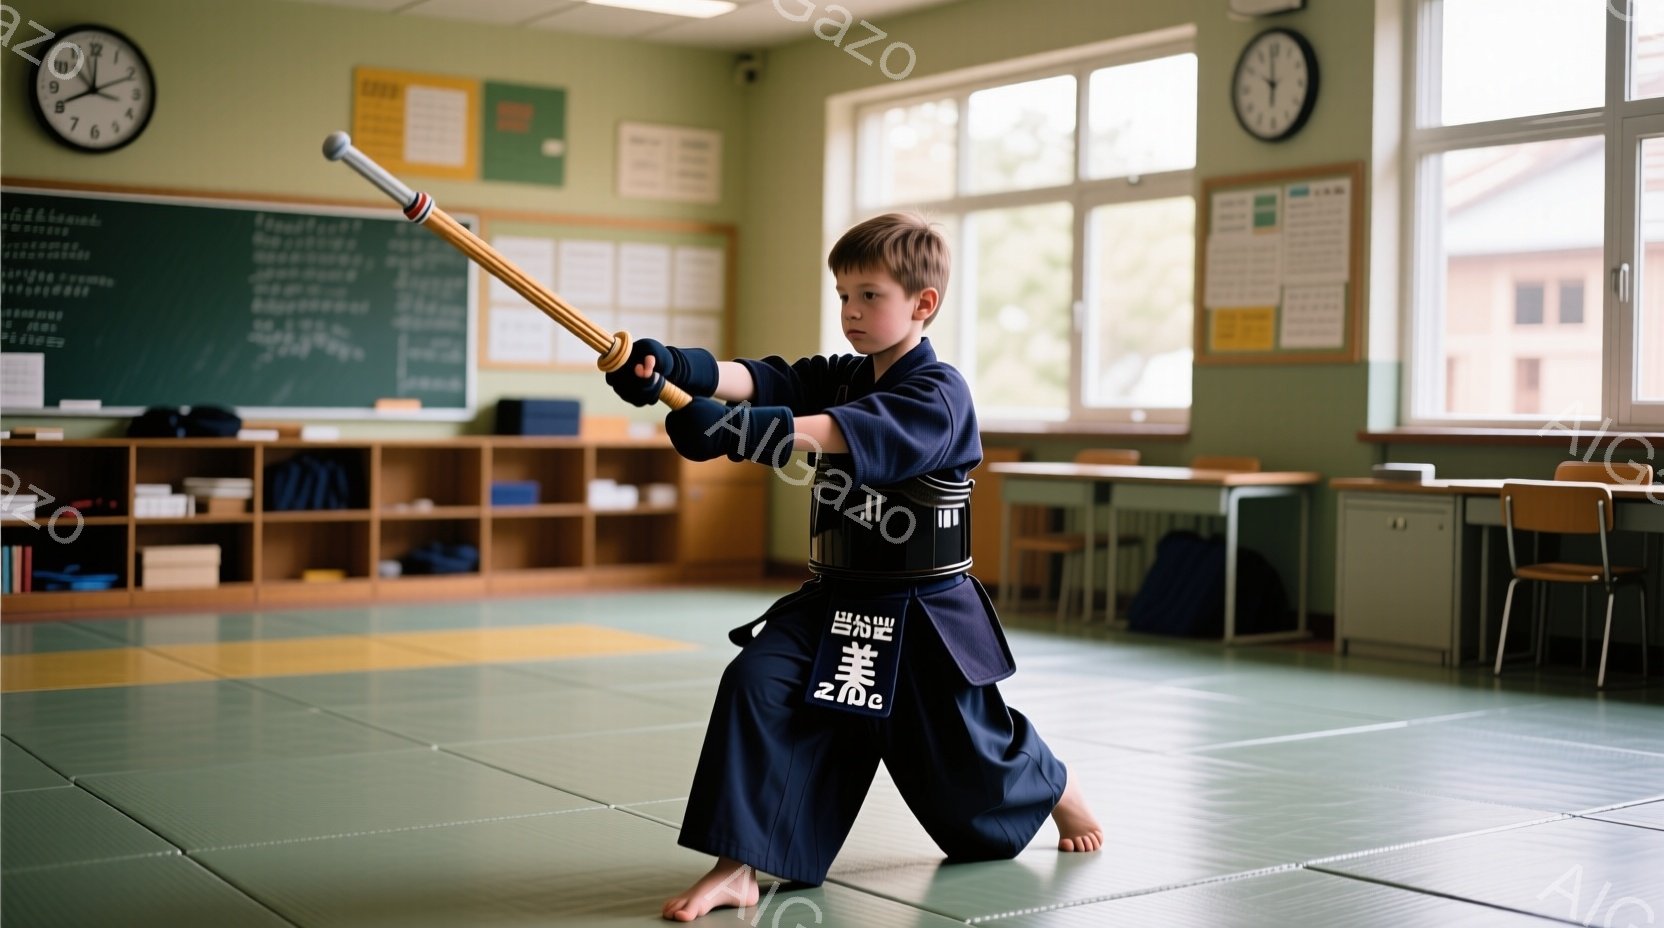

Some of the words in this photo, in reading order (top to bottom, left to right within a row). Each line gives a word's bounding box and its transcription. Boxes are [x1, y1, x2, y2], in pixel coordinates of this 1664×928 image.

[89, 42, 103, 57] 12
[114, 49, 120, 64] 1
[49, 81, 59, 94] 9
[54, 100, 65, 114] 8
[70, 116, 80, 132] 7
[90, 124, 100, 140] 6
